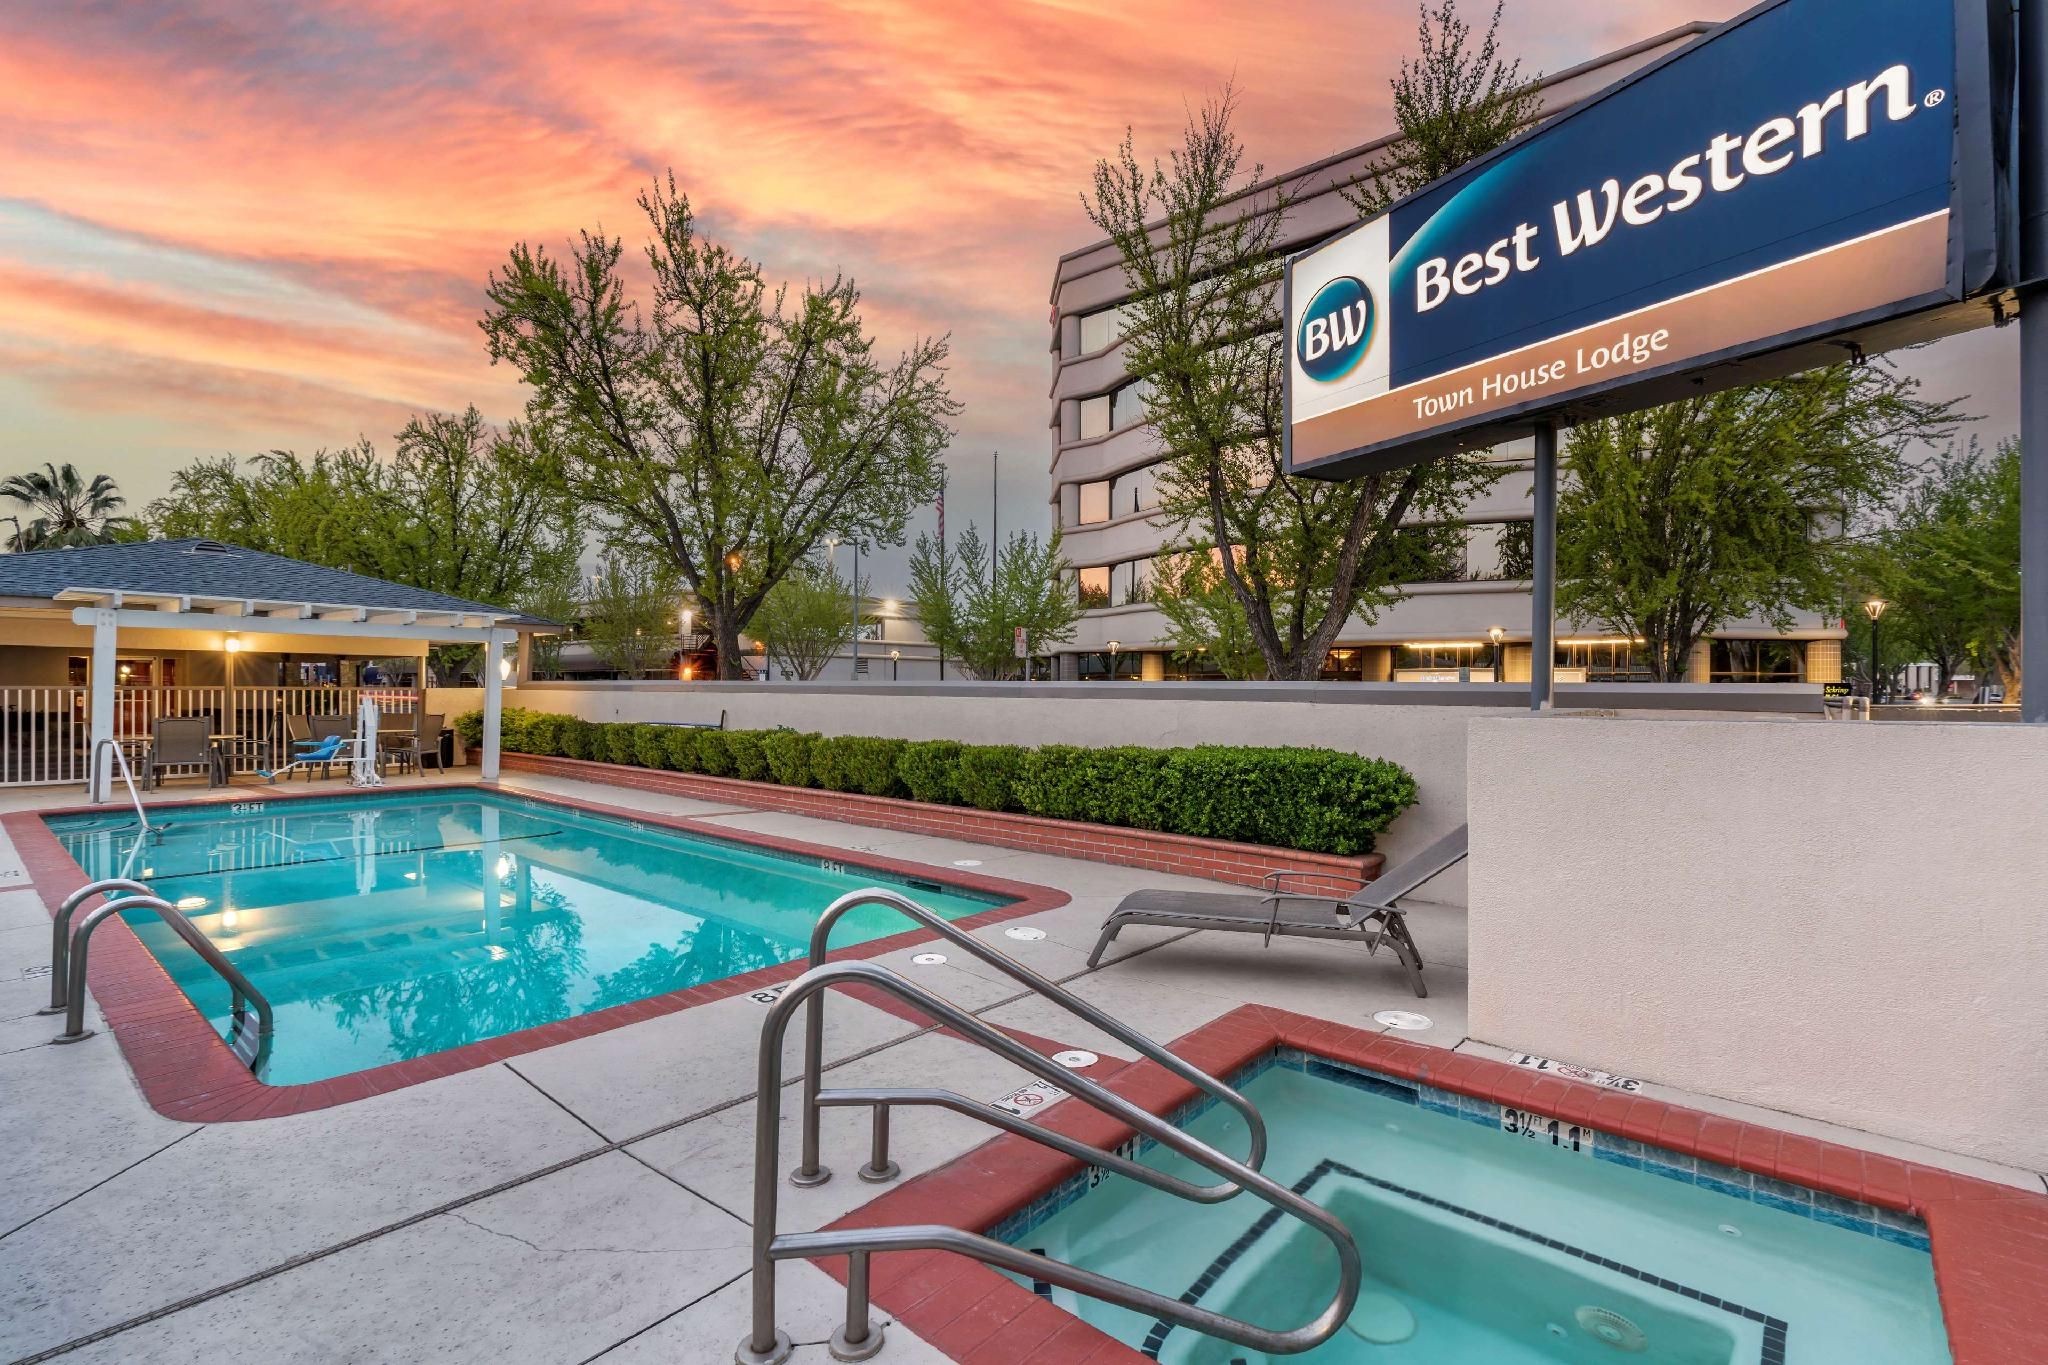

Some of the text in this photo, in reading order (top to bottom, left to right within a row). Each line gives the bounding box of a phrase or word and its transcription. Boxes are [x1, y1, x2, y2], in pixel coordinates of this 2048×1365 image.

[1414, 223, 1539, 314] Best
[1552, 64, 1917, 258] Western
[1305, 299, 1367, 362] BW
[1413, 328, 1669, 419] Town House Lodge
[1547, 1120, 1580, 1152] 1.1
[1583, 1129, 1591, 1139] M
